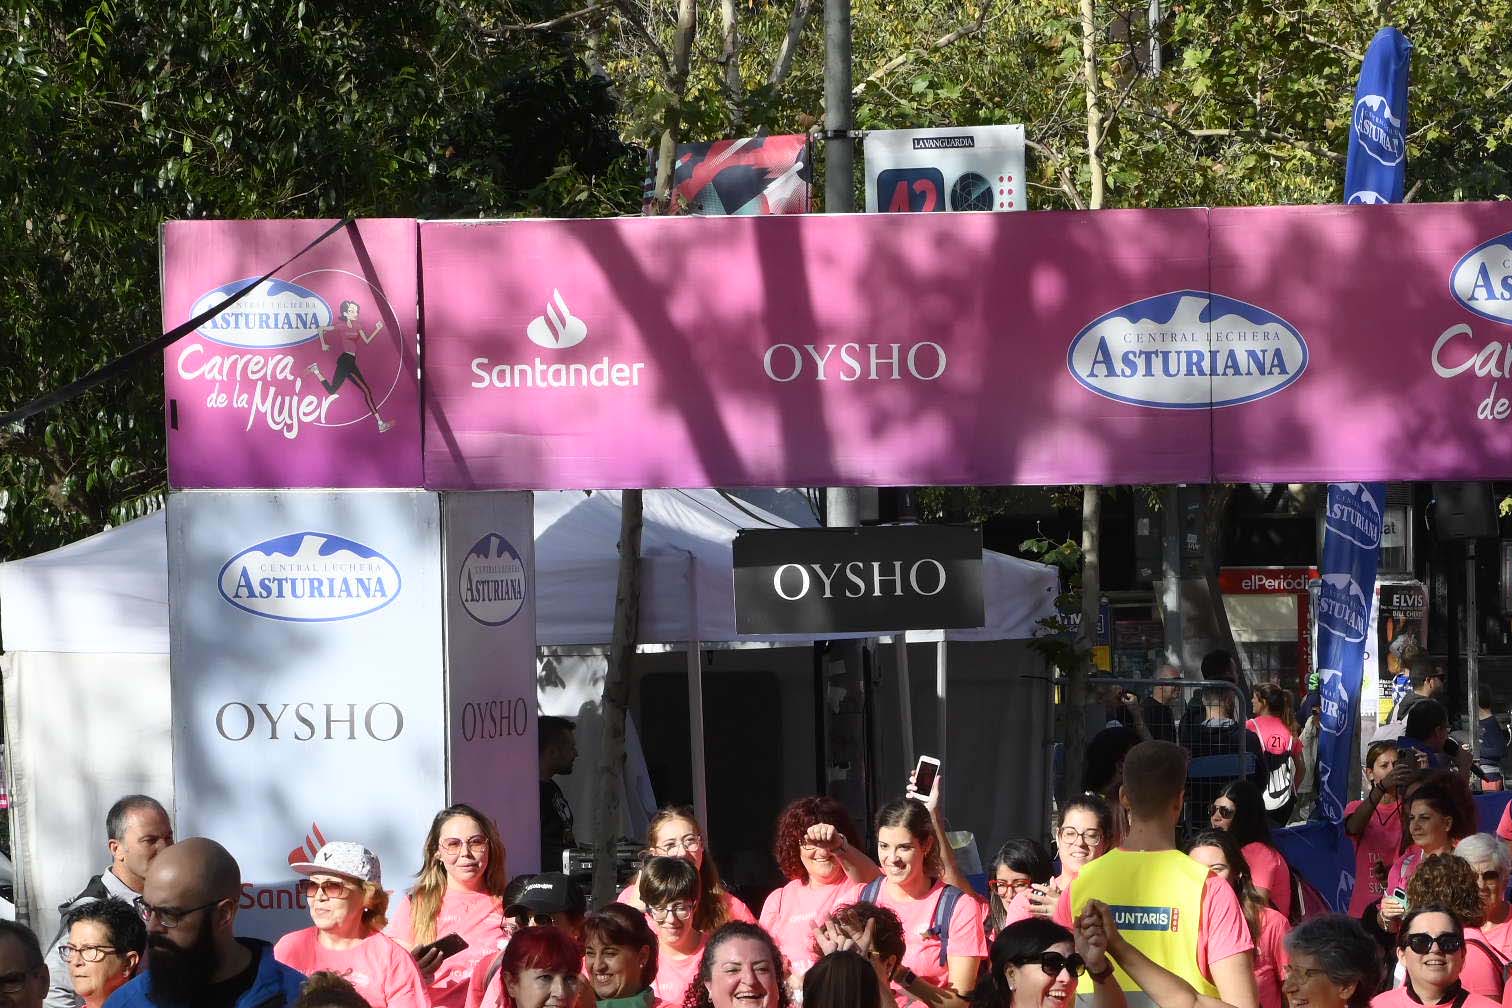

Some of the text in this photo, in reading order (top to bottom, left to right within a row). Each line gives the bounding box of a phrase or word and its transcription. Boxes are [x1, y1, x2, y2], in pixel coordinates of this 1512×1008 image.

[1123, 330, 1281, 343] CENTRAL LECHERA
[176, 343, 295, 381] Carrera
[471, 357, 645, 389] Santander
[763, 341, 948, 383] OYSHO
[1088, 336, 1290, 379] ASTURIANA
[206, 378, 340, 440] de la Mujer
[1477, 382, 1510, 421] de
[232, 565, 388, 600] ASTURIANA
[464, 571, 523, 604] ASTURIANA
[773, 558, 947, 600] OYSHO
[1393, 593, 1423, 607] ELVIS
[215, 701, 405, 742] OYSHO
[460, 697, 528, 742] OYSHO
